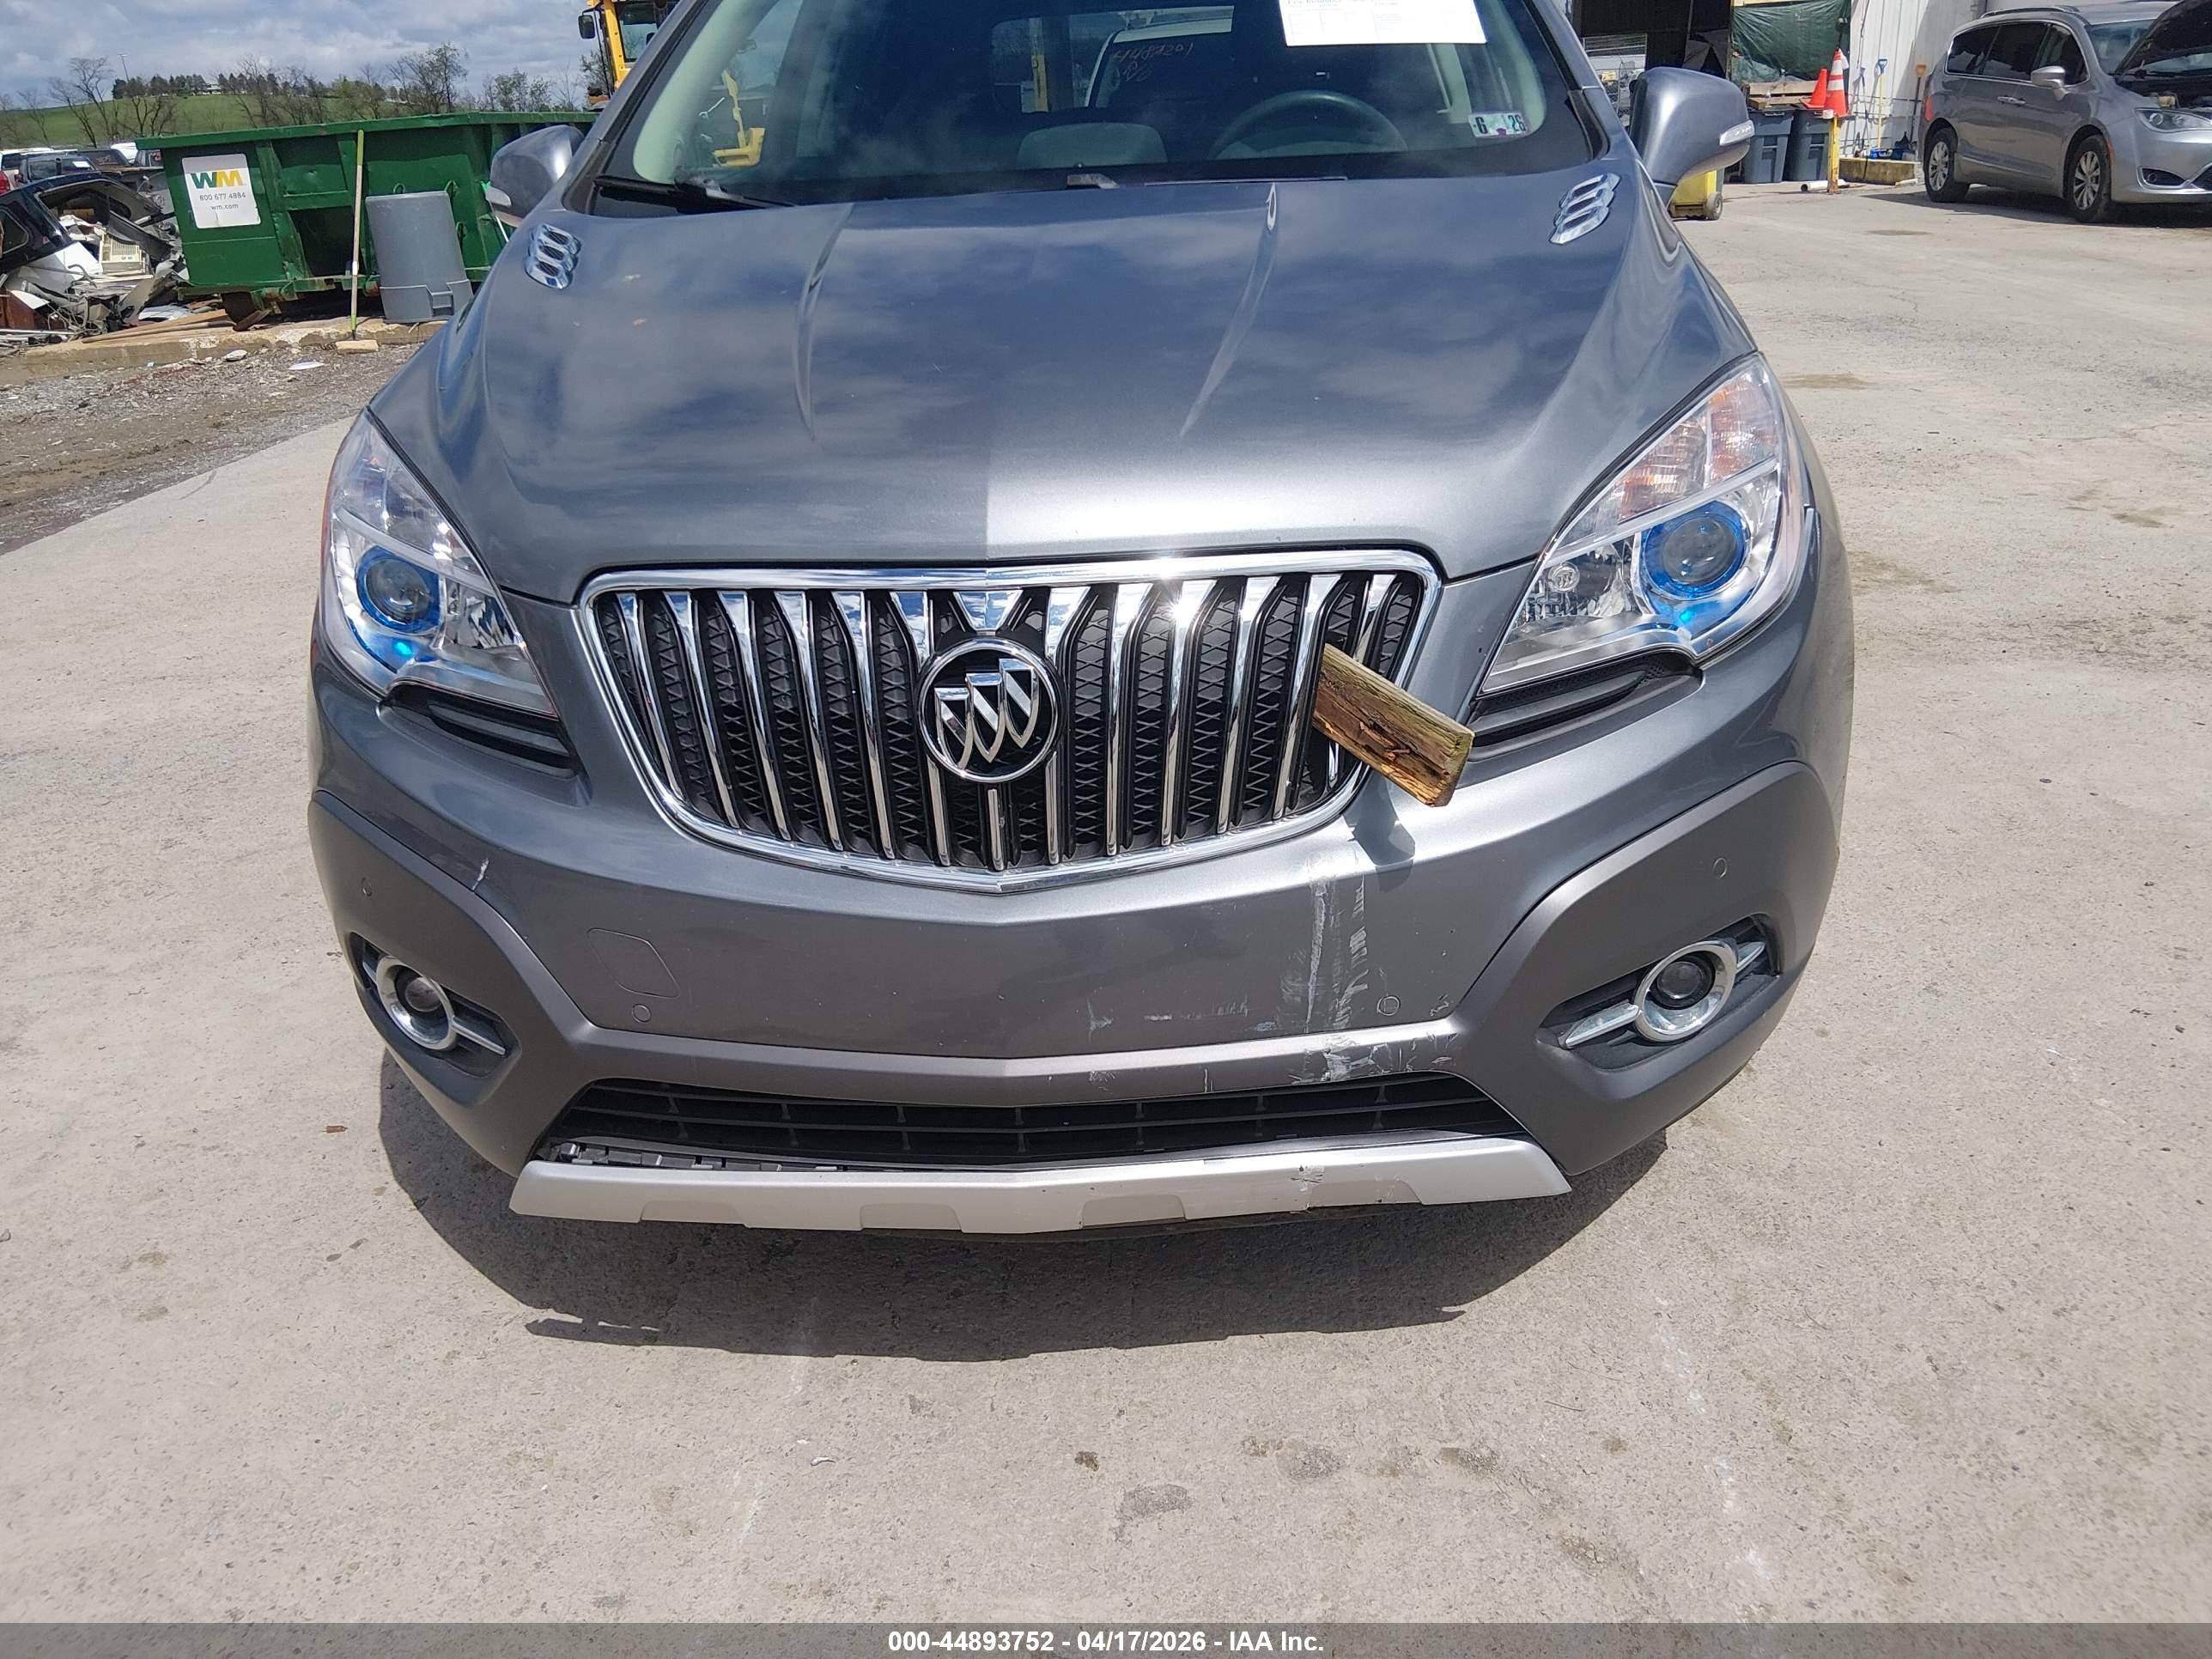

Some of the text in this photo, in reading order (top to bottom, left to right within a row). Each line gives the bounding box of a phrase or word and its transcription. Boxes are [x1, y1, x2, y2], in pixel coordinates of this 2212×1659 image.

[1475, 114, 1526, 134] 6 26
[191, 170, 244, 189] WM
